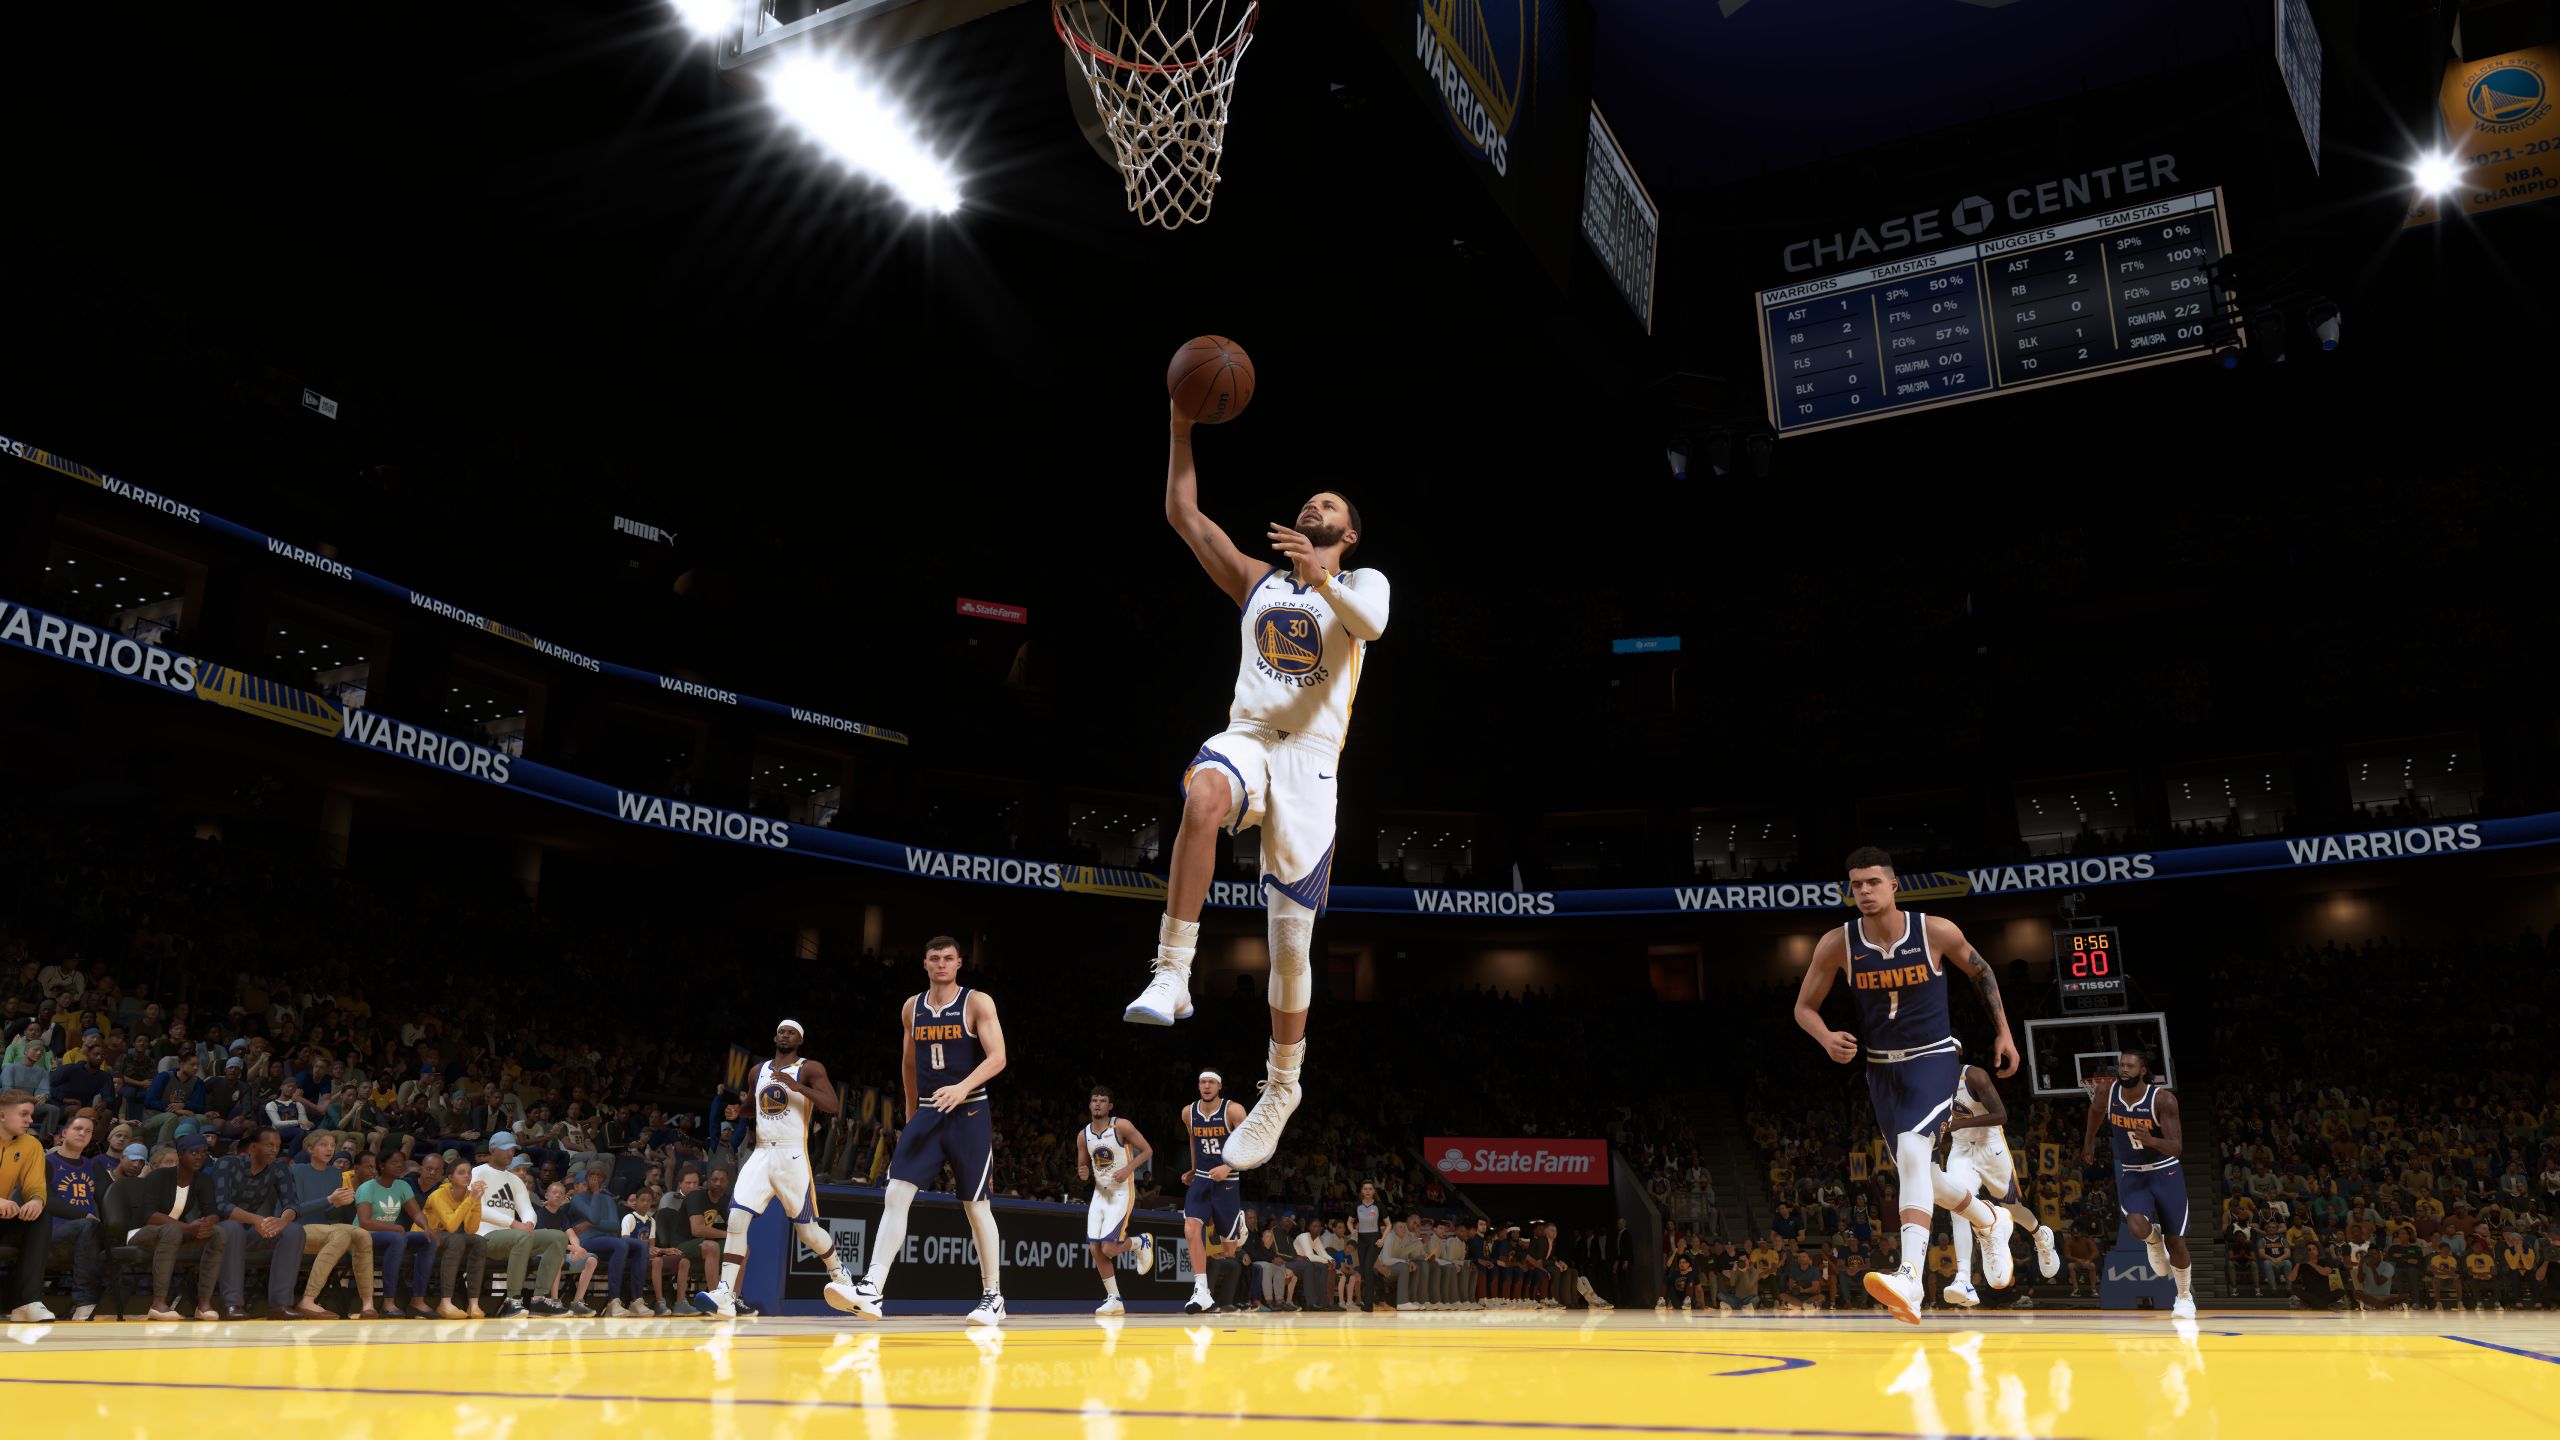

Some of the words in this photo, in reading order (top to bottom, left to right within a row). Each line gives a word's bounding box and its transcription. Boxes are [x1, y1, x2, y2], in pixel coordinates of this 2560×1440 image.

[1416, 13, 1508, 178] WARRIORS
[2474, 103, 2552, 134] WARRIORS
[2504, 166, 2544, 183] NBA
[2473, 176, 2560, 205] CHAMPIO
[1783, 208, 1944, 272] CHASE
[2005, 153, 2180, 221] CENTER
[1985, 230, 2055, 253] NUGGETS
[2098, 212, 2131, 228] TEAM
[2132, 204, 2170, 220] STATS
[2116, 236, 2142, 250] 3P%
[2163, 228, 2172, 239] 0
[2008, 259, 2030, 273] AST
[2064, 250, 2074, 261] 2
[2120, 260, 2145, 273] FT%
[2166, 249, 2191, 263] 100
[1766, 278, 1837, 302] WARRIORS
[1870, 264, 1901, 279] TEAM
[1903, 256, 1937, 272] STATS
[1885, 288, 1909, 301] 3P%
[1929, 279, 1948, 291] 50
[2011, 285, 2026, 297] RB
[2067, 274, 2078, 284] 2
[2124, 287, 2149, 300] FG%
[2170, 278, 2190, 291] 50
[1787, 309, 1807, 322] AST
[1841, 300, 1847, 310] 1
[1889, 311, 1911, 323] FT%
[1932, 303, 1941, 313] 0
[2016, 311, 2036, 324] FLS
[2071, 302, 2081, 312] 0
[2174, 303, 2200, 318] 2/2
[1790, 333, 1804, 344] RB
[1843, 323, 1851, 333] 2
[1892, 337, 1915, 349] FG%
[1935, 328, 1952, 341] 57
[2018, 336, 2038, 350] BLK
[2076, 328, 2082, 337] 1
[2177, 325, 2203, 339] 0/0
[1794, 358, 1811, 369] FLS
[1846, 349, 1853, 359] 1
[1939, 352, 1962, 366] 0/0
[2021, 359, 2037, 370] TO
[2078, 349, 2088, 360] 2
[1796, 383, 1814, 395] BLK
[1848, 375, 1857, 384] 0
[1942, 373, 1965, 386] 1/2
[1798, 404, 1813, 414] TO
[1850, 395, 1860, 404] 0
[101, 474, 200, 524] WARRIORS
[613, 514, 660, 543] PUMA
[267, 537, 353, 580] WARRIORS
[410, 592, 484, 629] WARRIORS
[1257, 602, 1296, 615] GOLDEN
[1300, 603, 1323, 620] STATE
[1288, 619, 1309, 639] 30
[534, 638, 600, 673] WARRIORS
[1256, 656, 1329, 688] WARRIORS
[660, 676, 737, 705] WARRIORS
[791, 708, 861, 735] WARRIORS
[343, 705, 510, 785] WARRIORS
[618, 790, 790, 848] WARRIORS
[2286, 823, 2482, 865] WARRIORS
[905, 846, 1061, 889] WARRIORS
[1968, 854, 2155, 894] WARRIORS
[1413, 888, 1555, 916] WARRIORS
[1676, 881, 1842, 909] WARRIORS
[2074, 935, 2109, 950] 8:56
[2072, 950, 2109, 977] 20
[1856, 963, 1929, 990] DENVER
[2080, 980, 2120, 990] TISSOT
[1888, 991, 1899, 1019] 1
[915, 1024, 962, 1040] DENVER
[930, 1043, 945, 1069] 0
[727, 1047, 749, 1089] W
[1193, 1126, 1225, 1137] DENVER
[2111, 1113, 2154, 1129] DENVER
[1201, 1138, 1221, 1155] 32
[2127, 1131, 2144, 1150] 6
[2043, 1147, 2056, 1168] S
[57, 1171, 78, 1192] MILE
[72, 1183, 87, 1198] 15
[69, 1198, 90, 1206] CITY
[487, 1199, 515, 1210] adida
[834, 1231, 860, 1246] NEW
[1015, 1240, 1052, 1268] CAP
[1056, 1242, 1079, 1269] OF
